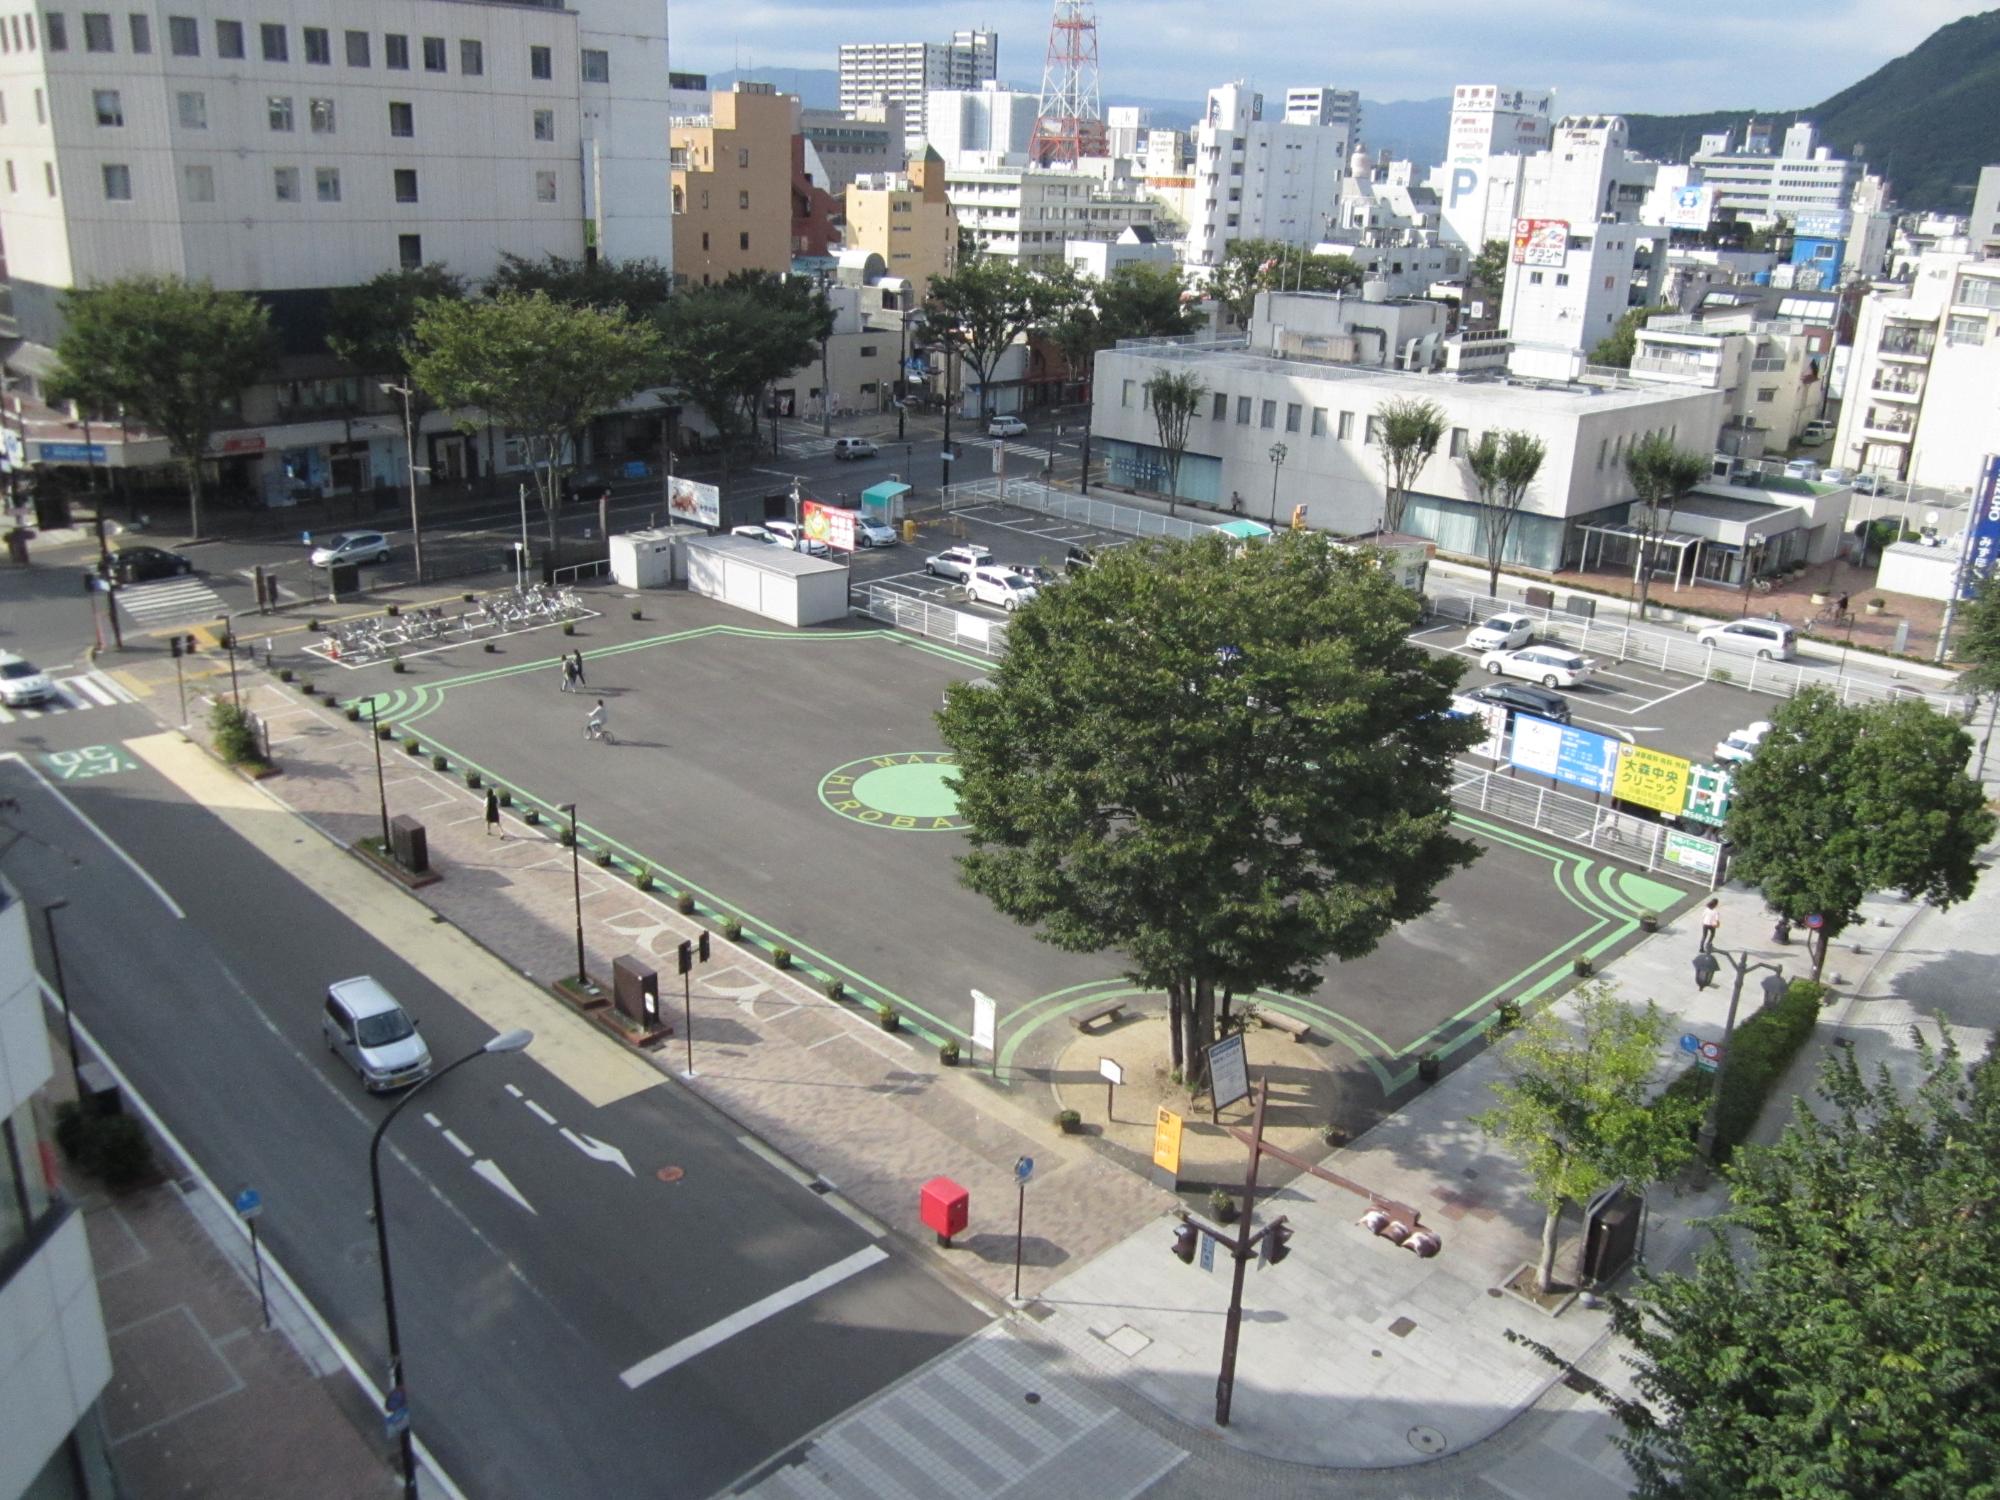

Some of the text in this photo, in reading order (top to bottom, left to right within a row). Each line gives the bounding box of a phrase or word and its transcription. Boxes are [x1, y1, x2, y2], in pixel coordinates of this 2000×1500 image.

[1449, 168, 1478, 209] P
[1622, 772, 1677, 796] クリニック
[1624, 759, 1679, 785] 大森中央
[825, 774, 954, 829] HIROBA
